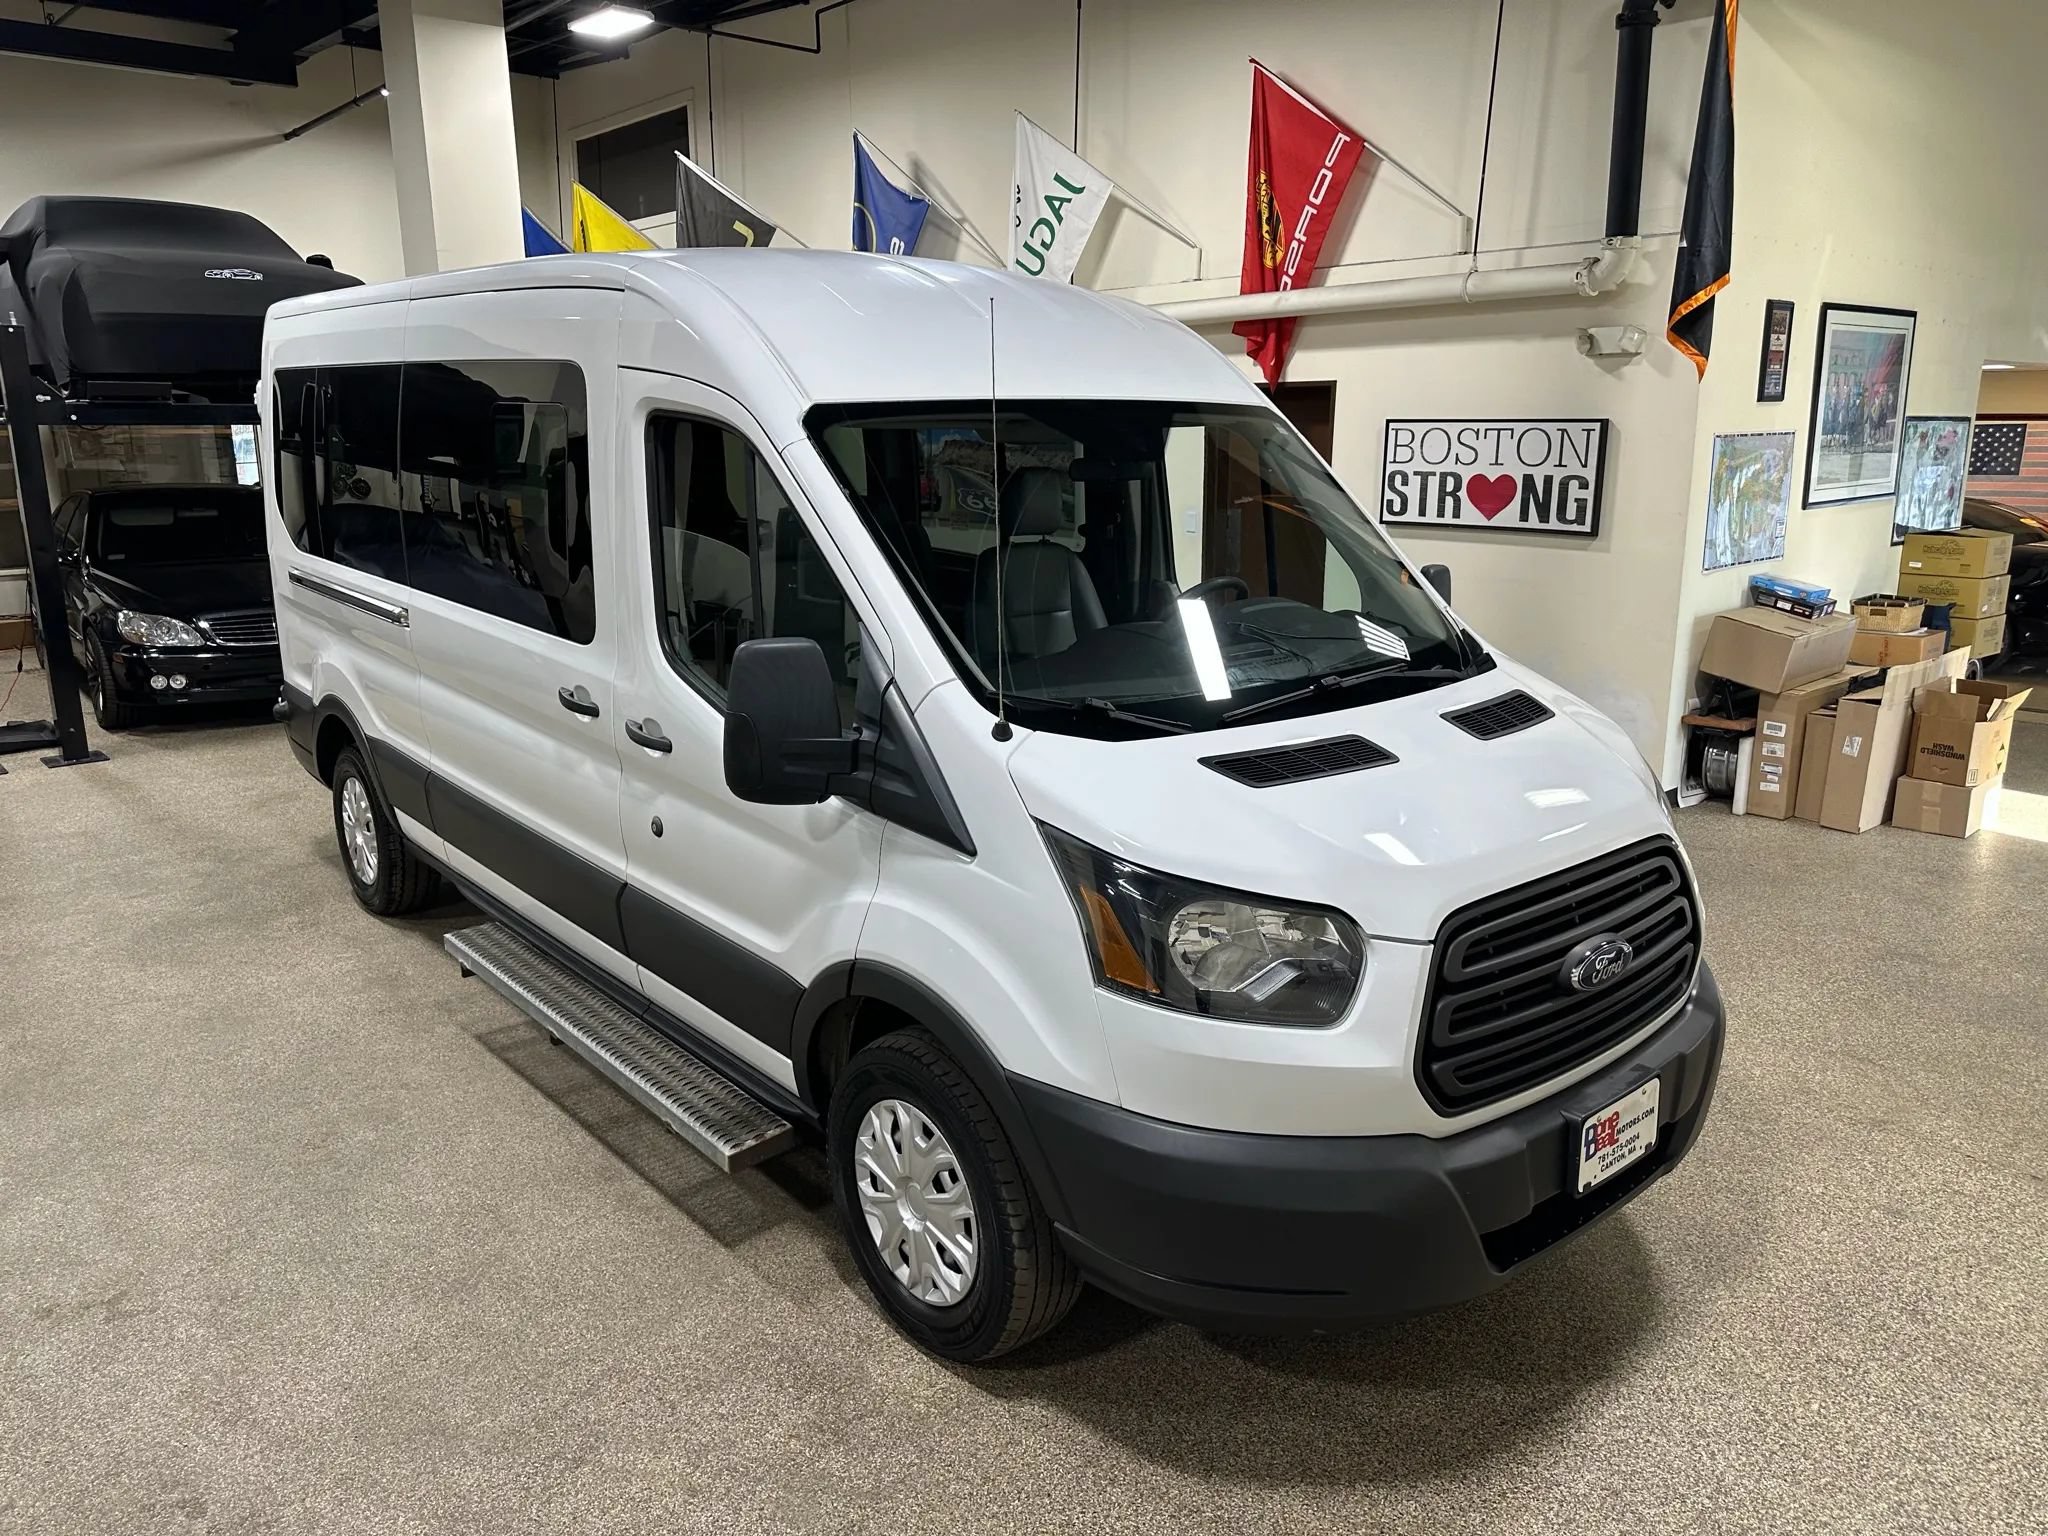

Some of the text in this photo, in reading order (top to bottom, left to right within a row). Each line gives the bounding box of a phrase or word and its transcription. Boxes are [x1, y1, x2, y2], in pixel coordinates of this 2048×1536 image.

[1388, 427, 1596, 468] BOSTON
[1920, 747, 1965, 761] WINDSHIELD
[1932, 742, 1955, 752] WASH
[1592, 952, 1625, 984] Ford
[1616, 1106, 1655, 1137] MOTORS.COM
[1597, 1132, 1640, 1166] 781-575-0004
[1600, 1145, 1637, 1172] CANTON, MA
